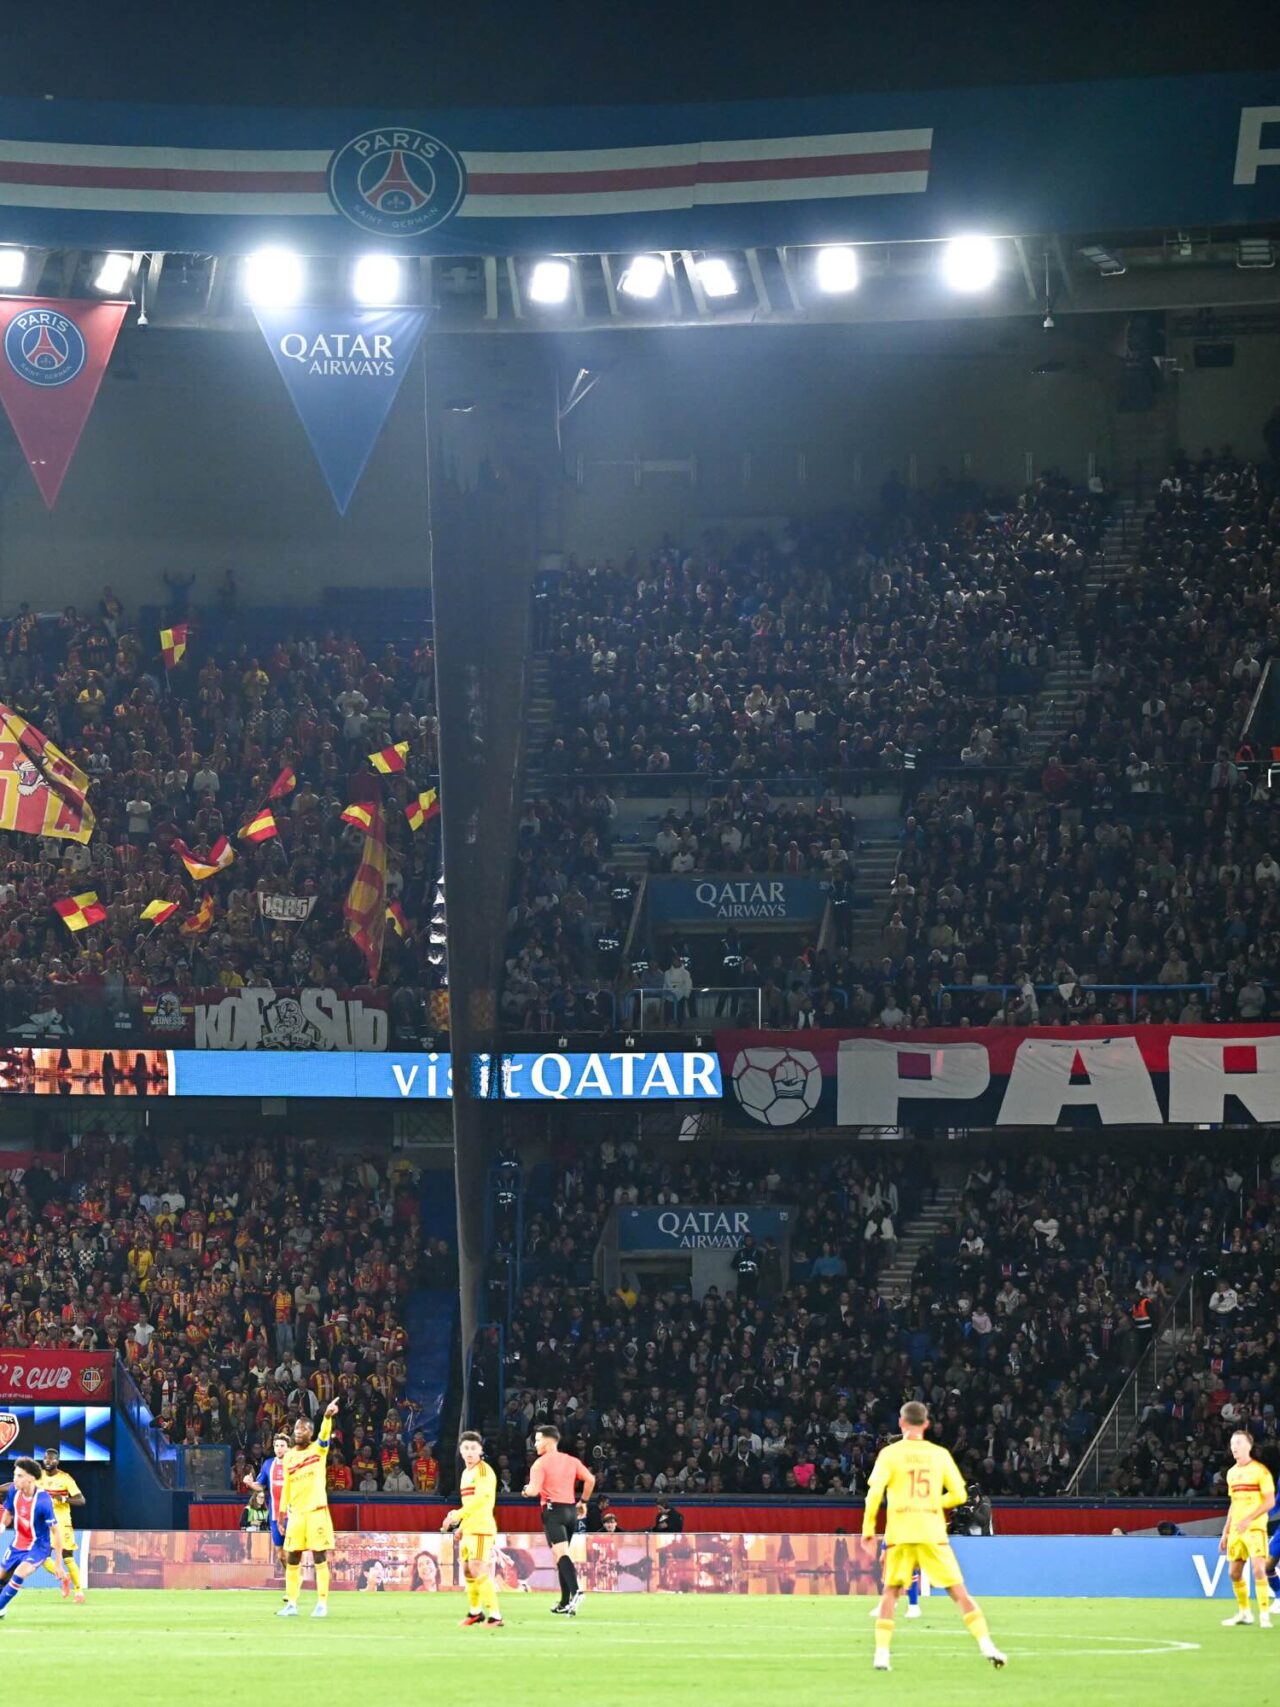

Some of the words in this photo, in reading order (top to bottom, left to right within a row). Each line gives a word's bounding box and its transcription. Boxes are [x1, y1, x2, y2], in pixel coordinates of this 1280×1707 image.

[353, 132, 440, 159] PARIS
[352, 203, 384, 226] SAINT
[391, 206, 439, 229] GERMAIN
[16, 313, 70, 333] PARIS
[280, 333, 395, 363] QATAR
[308, 360, 395, 377] AIRWAYS
[695, 882, 785, 907] QATAR
[717, 903, 787, 918] AIRWAYS
[392, 1053, 718, 1099] viitQATAR
[837, 1036, 1280, 1126] PAR
[658, 1212, 750, 1237] QATAR
[680, 1235, 746, 1248] AIRWAY
[26, 1367, 72, 1390] CLUB
[907, 1468, 931, 1499] 15
